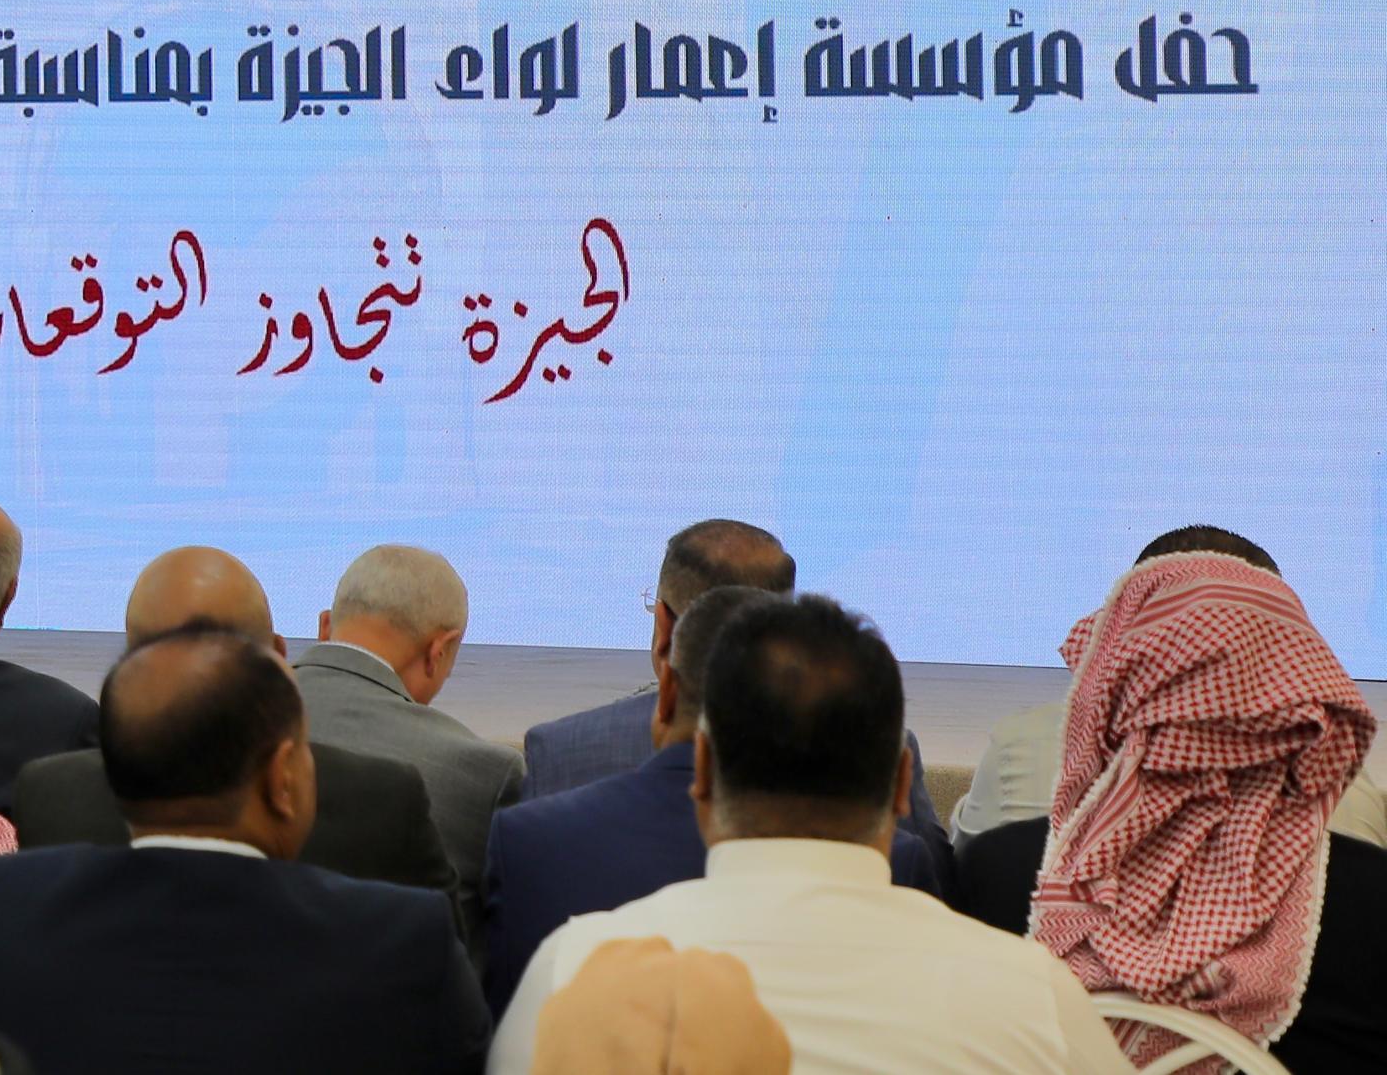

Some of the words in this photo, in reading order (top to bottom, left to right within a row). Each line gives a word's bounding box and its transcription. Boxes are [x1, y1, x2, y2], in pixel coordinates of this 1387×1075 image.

[238, 25, 406, 122] الجيزة
[435, 22, 579, 115] لواء
[606, 21, 777, 122] إعمار
[804, 9, 1083, 113] مؤسسة
[1115, 13, 1259, 102] حفل
[237, 234, 421, 383] تتجاوز
[462, 218, 629, 403] الجيزة
